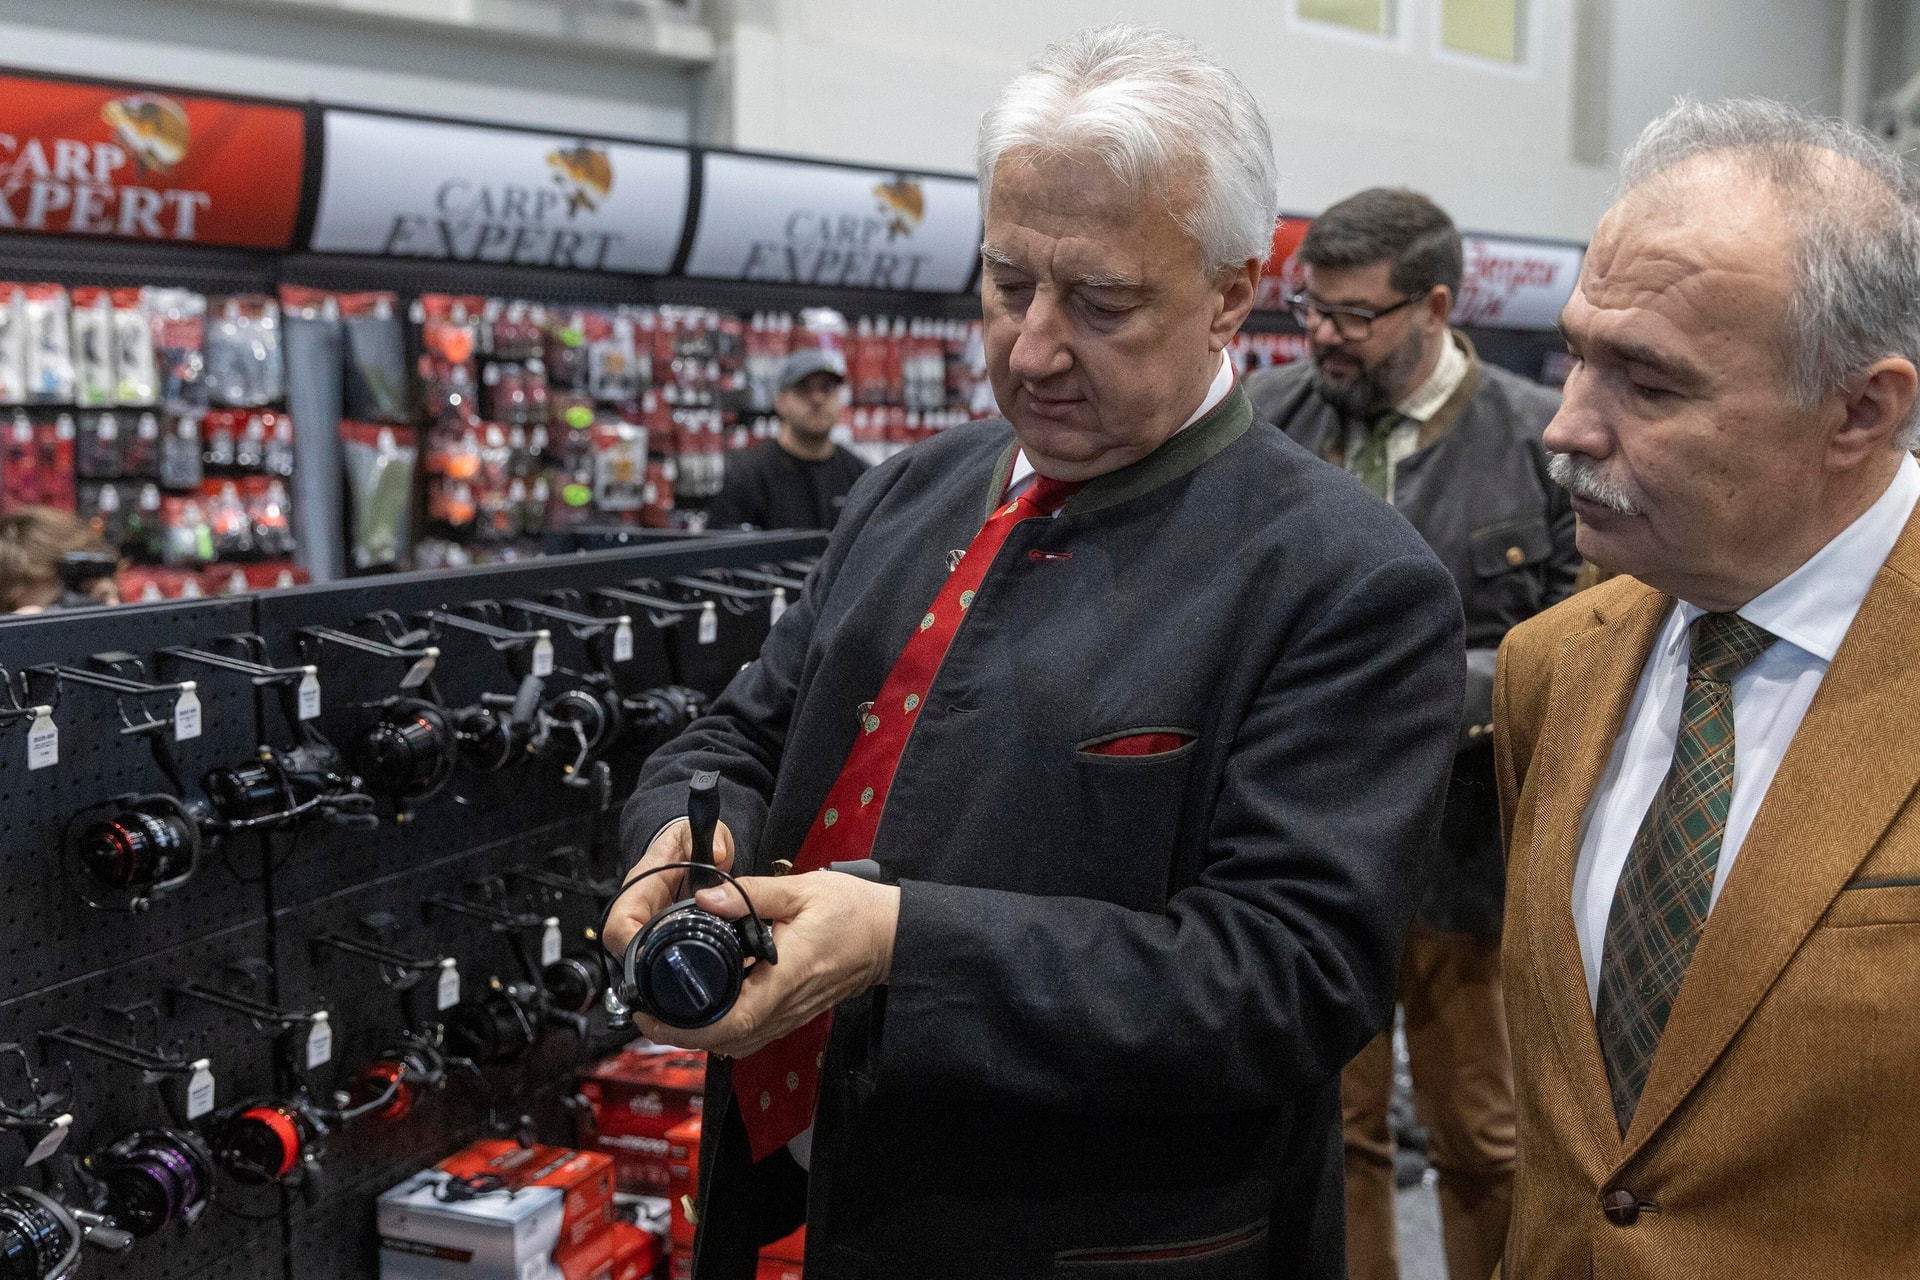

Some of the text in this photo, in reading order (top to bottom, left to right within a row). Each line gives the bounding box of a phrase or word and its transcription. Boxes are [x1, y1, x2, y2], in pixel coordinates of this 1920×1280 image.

[434, 178, 558, 222] CARP
[382, 211, 625, 269] EXPERT
[784, 208, 881, 246] CARP
[739, 241, 932, 290] EXPERT
